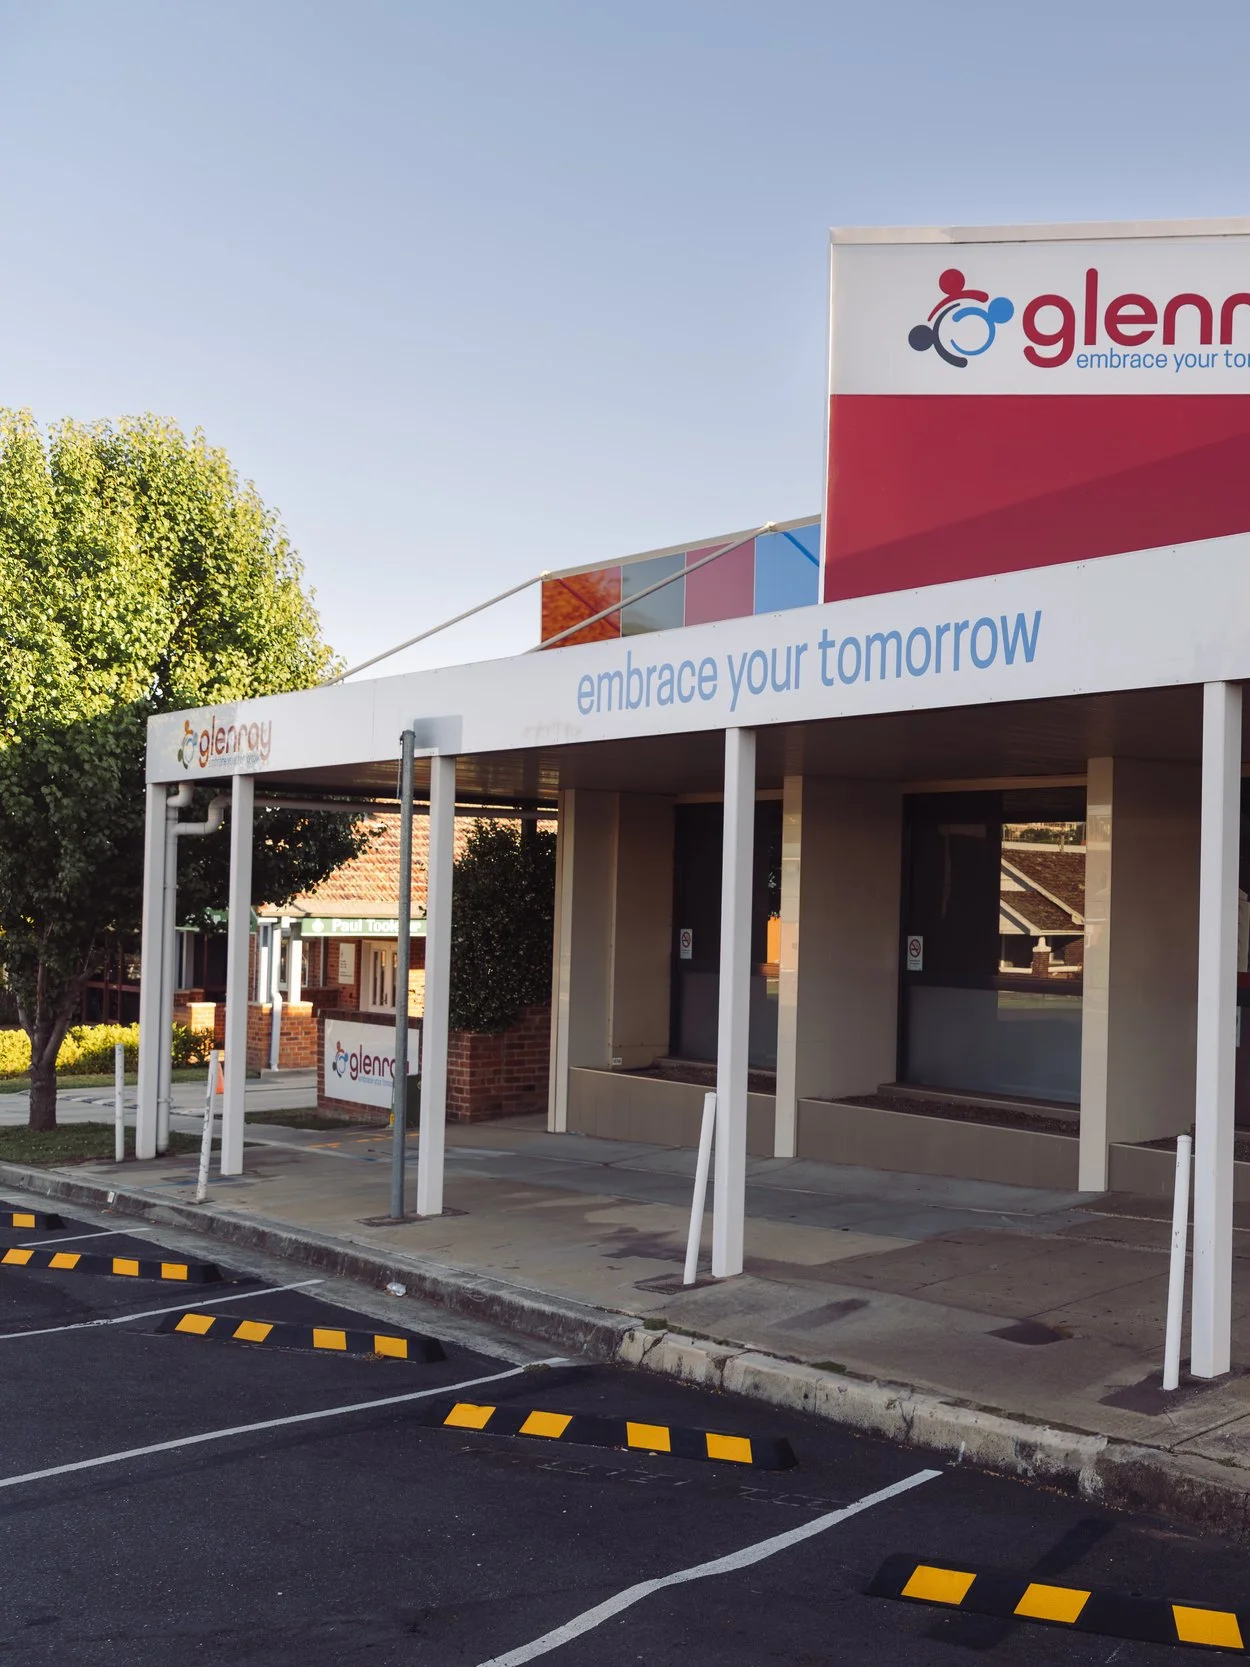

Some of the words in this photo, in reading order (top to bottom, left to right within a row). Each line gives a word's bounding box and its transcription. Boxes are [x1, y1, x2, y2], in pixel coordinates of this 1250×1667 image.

[1076, 348, 1167, 369] embrace
[1173, 352, 1218, 373] your
[577, 650, 718, 716] embrace
[727, 642, 808, 712] your
[818, 610, 1042, 687] tomorrow
[199, 715, 272, 768] glenray
[331, 918, 362, 932] Paul
[350, 1044, 409, 1080] glenra
